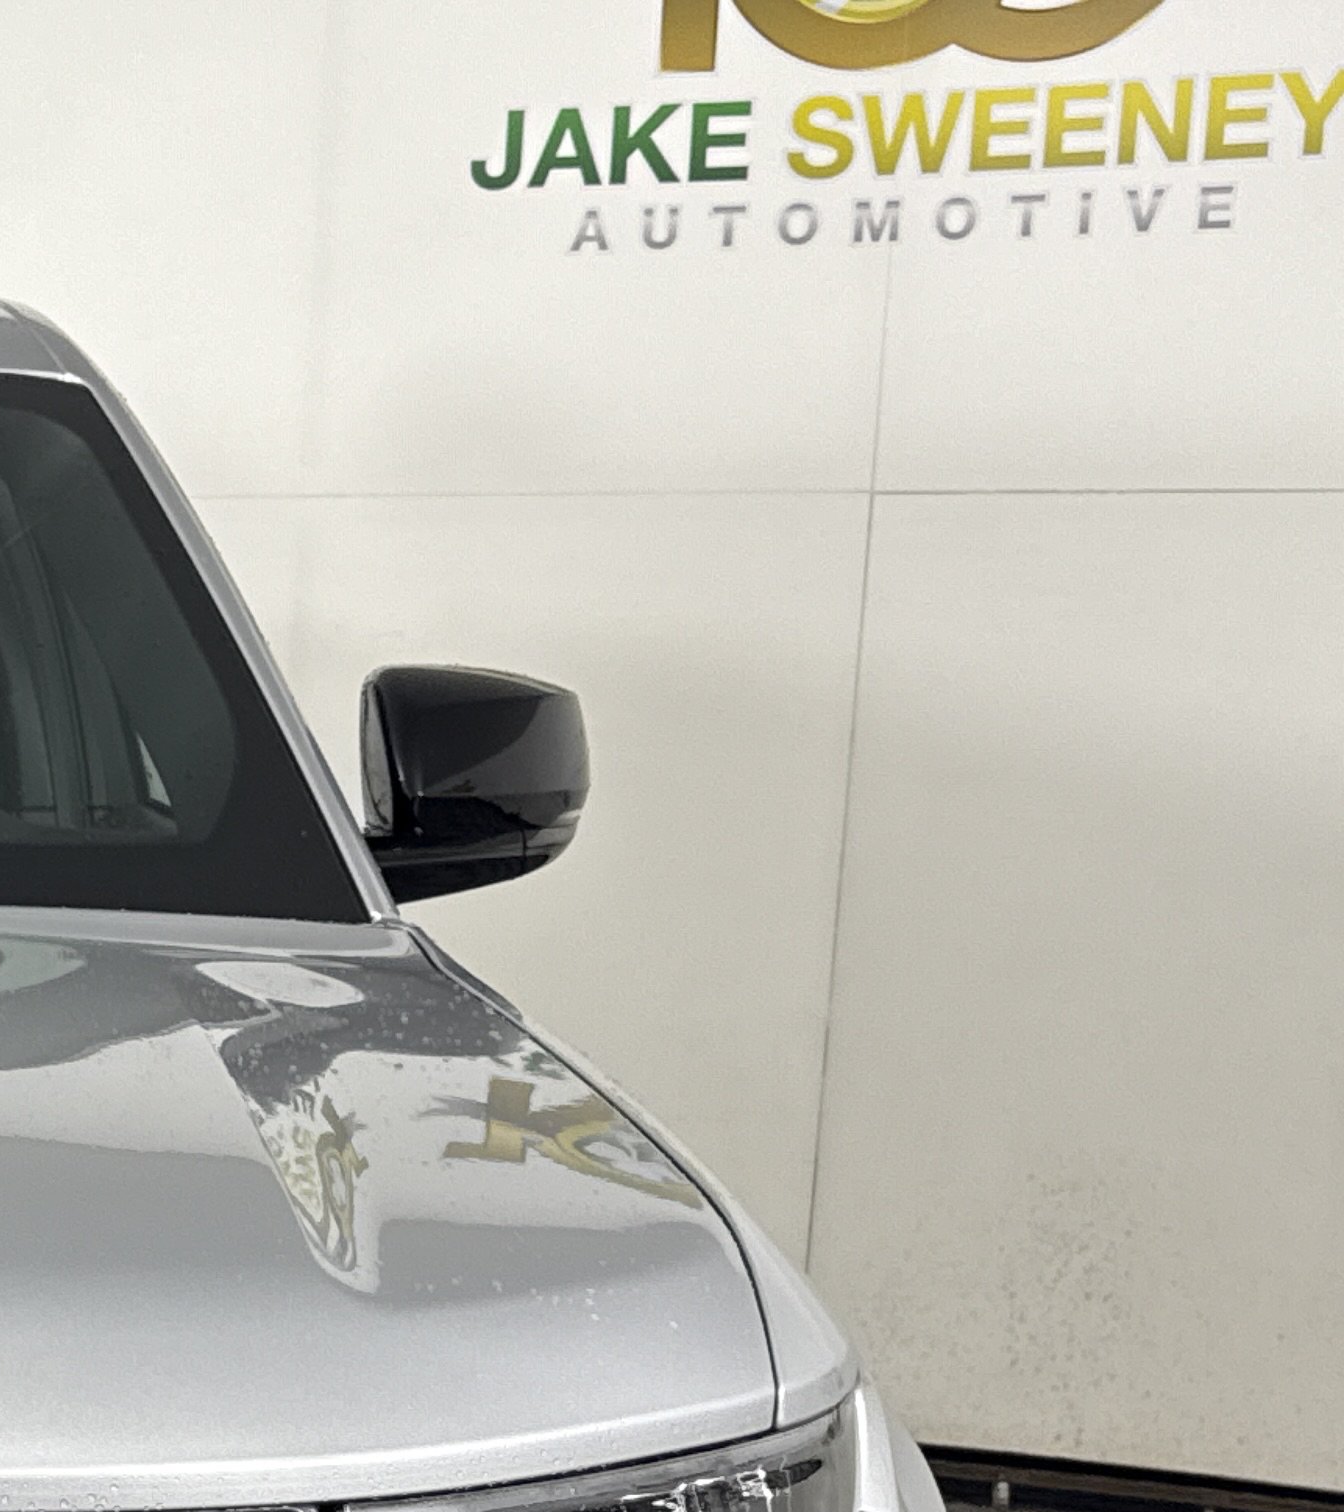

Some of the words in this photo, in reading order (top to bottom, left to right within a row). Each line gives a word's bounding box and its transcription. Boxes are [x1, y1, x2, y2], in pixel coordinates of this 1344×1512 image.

[470, 100, 753, 191] JAKE
[786, 69, 1344, 181] SWEENEY
[569, 186, 1234, 253] AUTOMOTIVE
